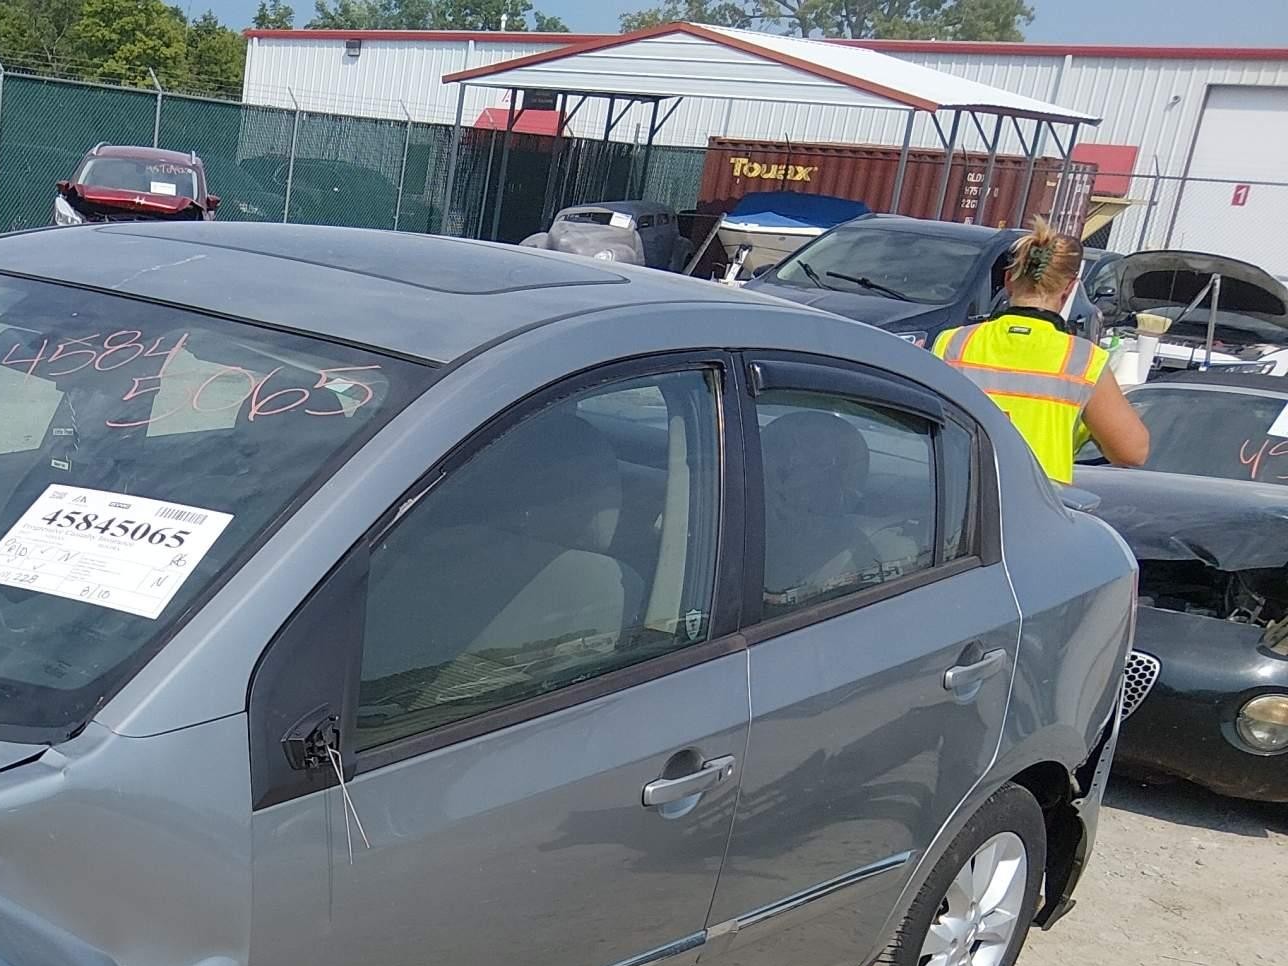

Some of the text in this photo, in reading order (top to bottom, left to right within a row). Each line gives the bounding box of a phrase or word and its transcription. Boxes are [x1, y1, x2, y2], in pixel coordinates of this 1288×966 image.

[1237, 187, 1247, 204] 1
[2, 330, 189, 383] 4584
[106, 365, 382, 427] 5065
[41, 508, 192, 549] 45845065
